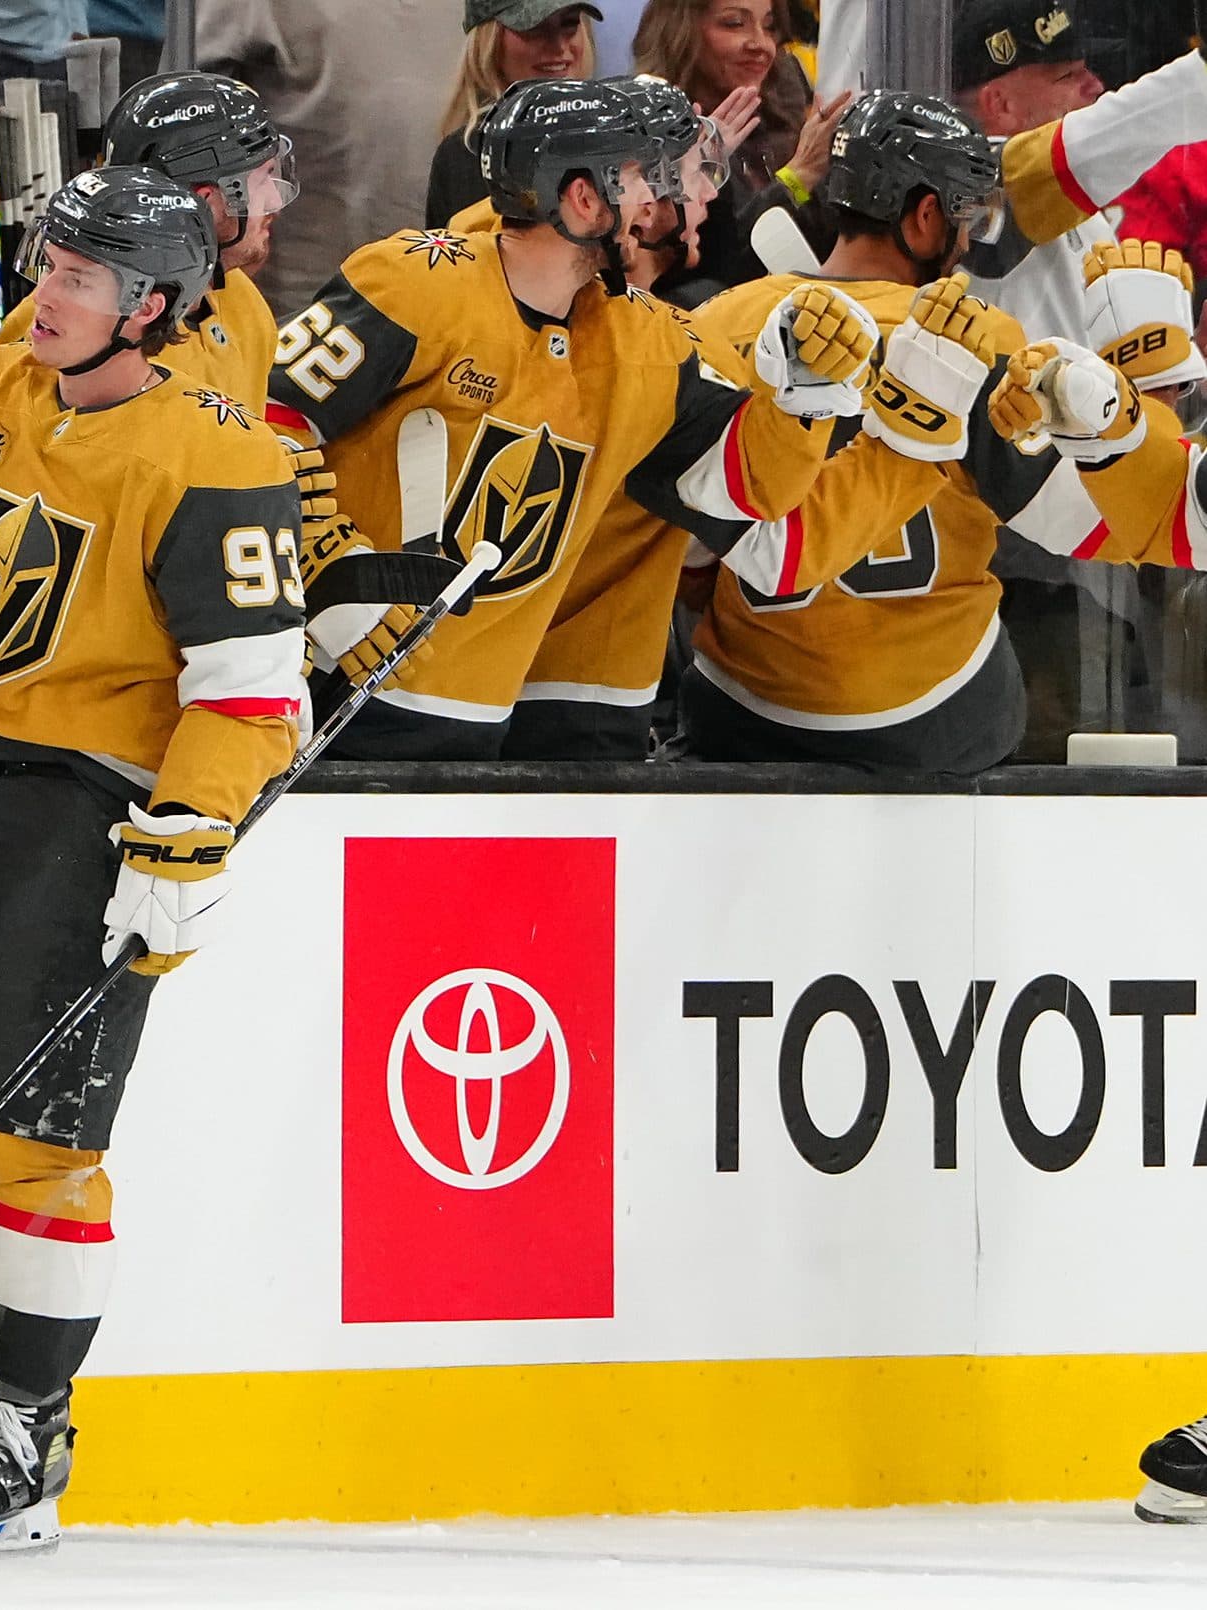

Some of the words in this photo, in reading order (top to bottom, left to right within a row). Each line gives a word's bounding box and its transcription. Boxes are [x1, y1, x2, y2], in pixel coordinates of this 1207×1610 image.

[534, 98, 599, 118] CreditOne
[275, 302, 365, 403] 62
[448, 358, 497, 388] Circa
[458, 384, 494, 403] SPORTS
[222, 526, 306, 609] 93
[349, 649, 406, 708] TRUE
[682, 972, 1207, 1174] TOYOT
